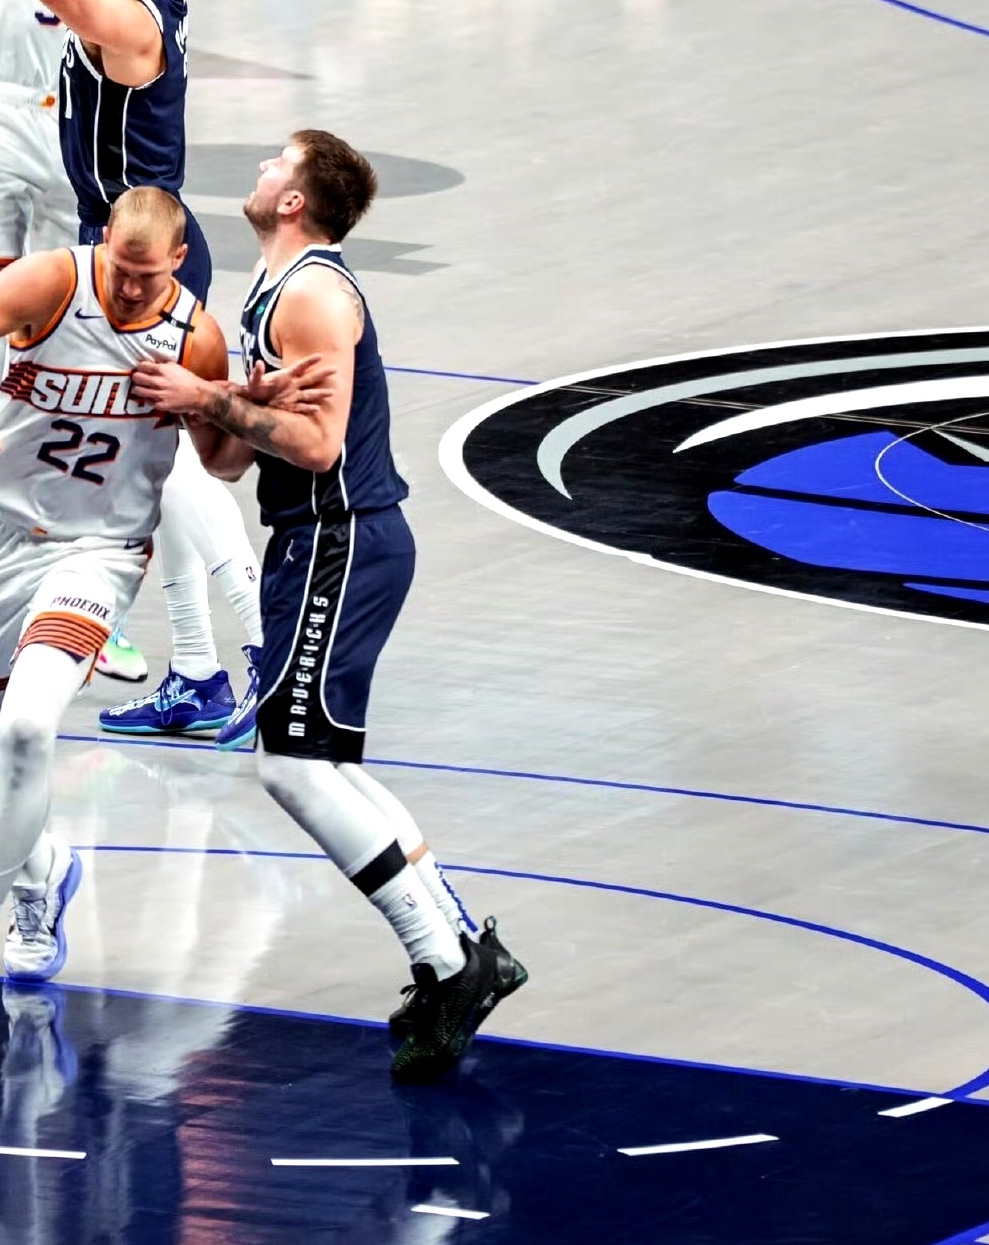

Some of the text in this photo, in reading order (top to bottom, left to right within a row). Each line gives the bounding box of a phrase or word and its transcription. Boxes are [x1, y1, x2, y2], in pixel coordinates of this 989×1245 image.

[145, 333, 177, 352] PayPal
[36, 419, 121, 486] 22
[50, 596, 111, 621] PHOENIX
